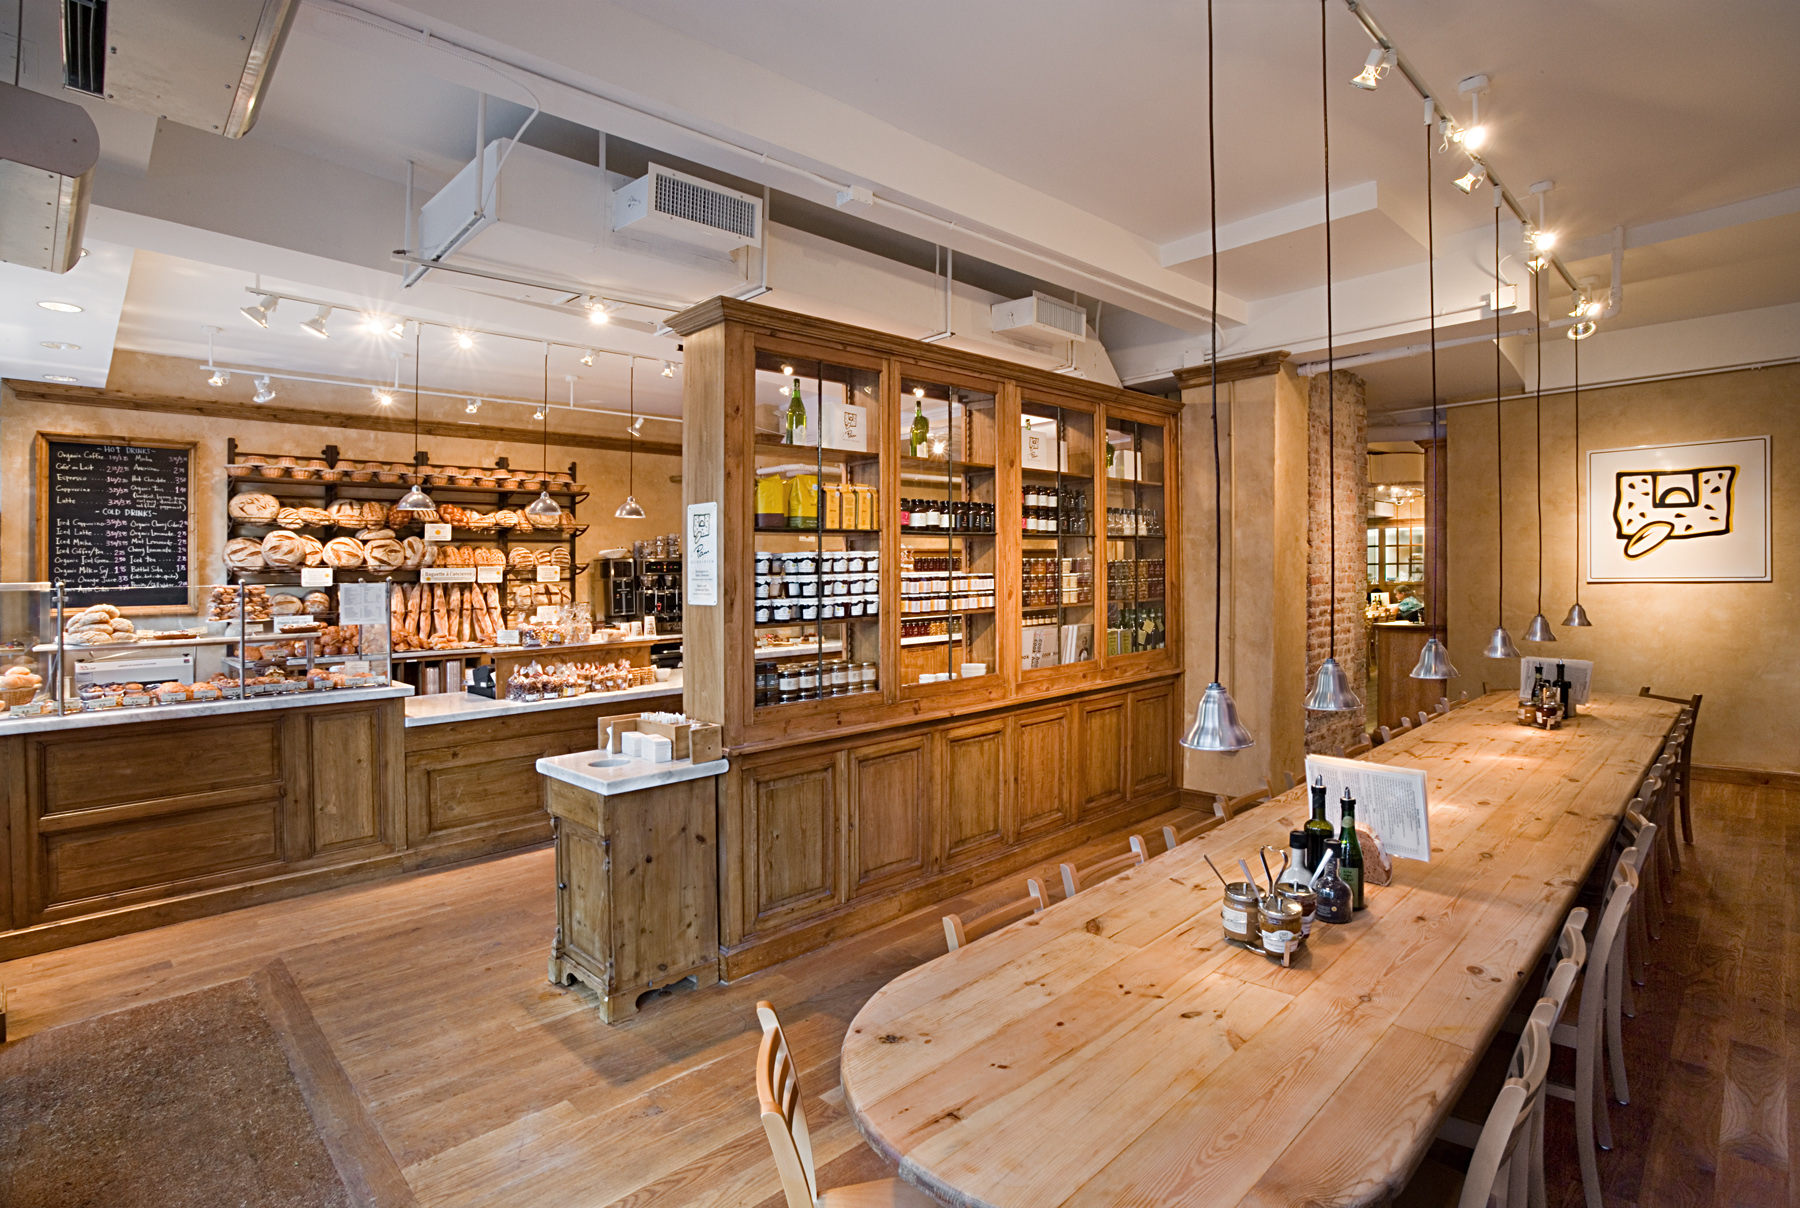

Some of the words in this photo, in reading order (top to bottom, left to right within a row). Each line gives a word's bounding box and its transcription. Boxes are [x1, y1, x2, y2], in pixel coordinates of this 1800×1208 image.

[56, 473, 87, 482] Espresso
[56, 496, 76, 504] Latte
[102, 507, 121, 516] COLD
[124, 508, 152, 517] DRINKS
[56, 518, 70, 527] Iced
[56, 527, 71, 535] Iced
[74, 528, 93, 536] Latte
[55, 537, 71, 545] Iced
[55, 547, 70, 555] Iced
[77, 575, 100, 586] Orange
